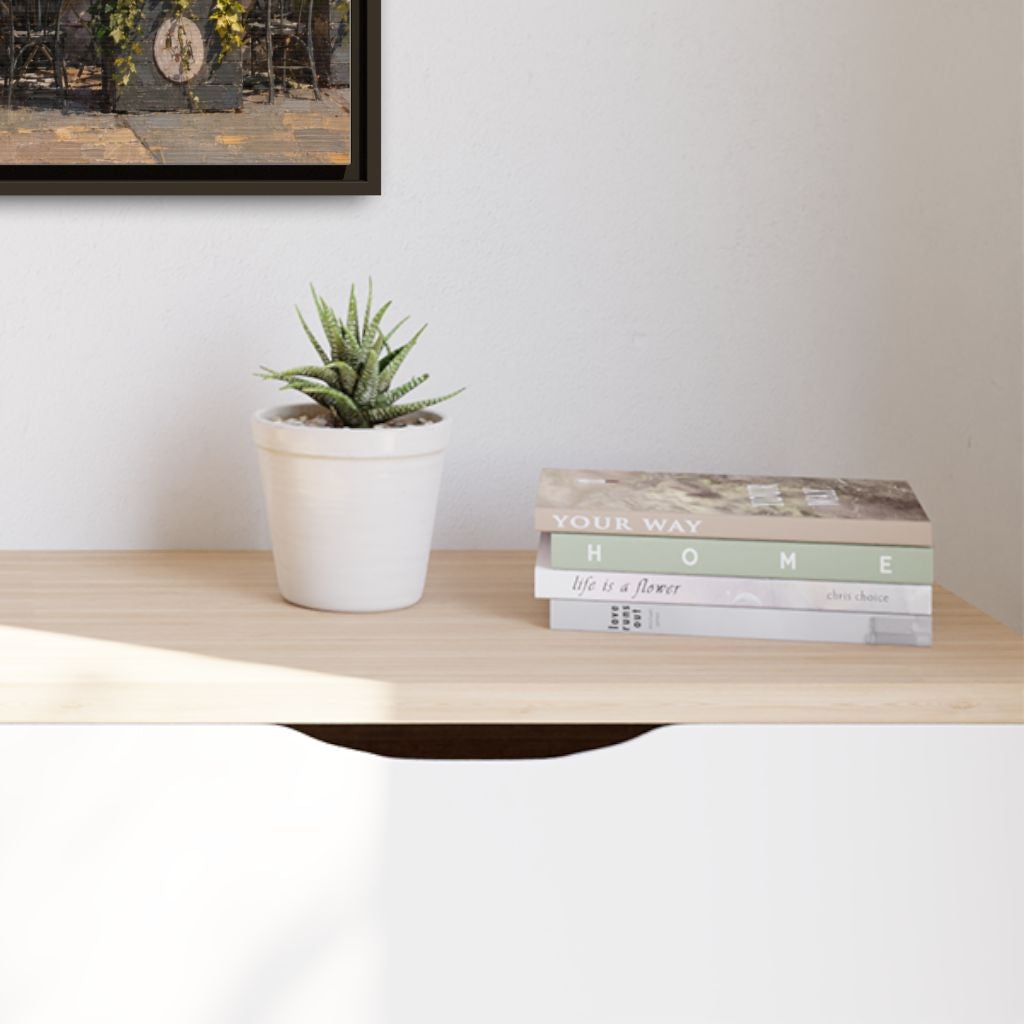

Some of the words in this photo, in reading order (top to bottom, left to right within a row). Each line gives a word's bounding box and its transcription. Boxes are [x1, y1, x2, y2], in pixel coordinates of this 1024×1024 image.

[552, 514, 632, 531] YOUR
[643, 518, 703, 533] WAY
[587, 543, 893, 574] HOME
[572, 575, 596, 596] life
[602, 579, 615, 592] is
[619, 583, 630, 593] a
[631, 577, 682, 599] flower
[607, 606, 619, 629] love
[621, 605, 631, 631] runs
[632, 608, 642, 628] out
